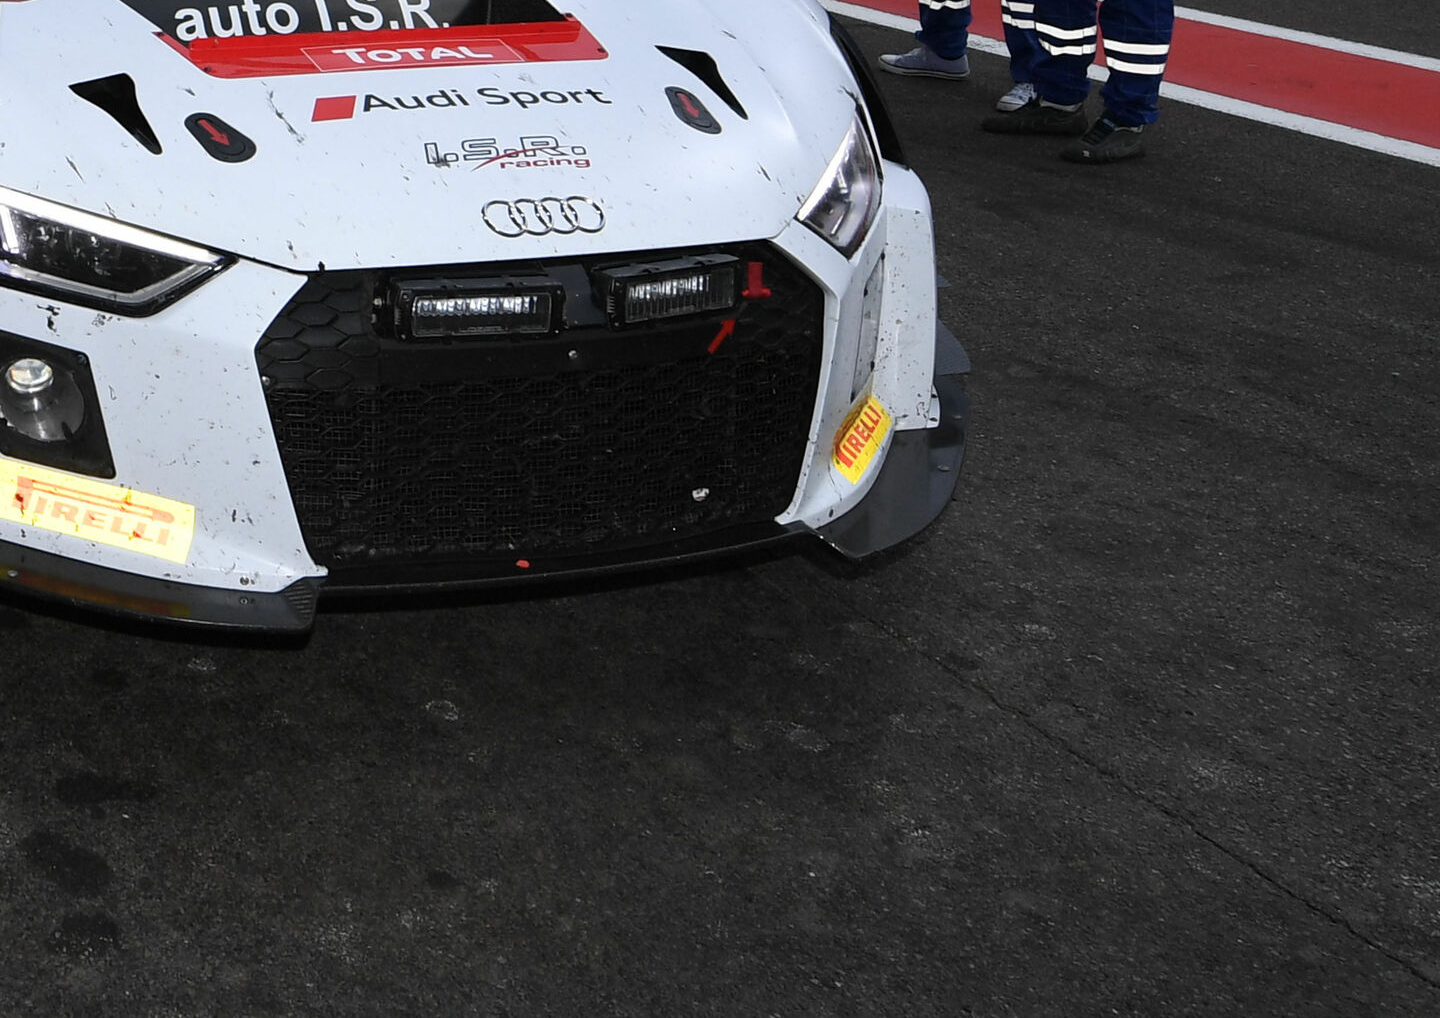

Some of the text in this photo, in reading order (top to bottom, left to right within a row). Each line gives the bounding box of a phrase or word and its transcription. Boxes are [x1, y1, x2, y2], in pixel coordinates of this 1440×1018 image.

[331, 45, 494, 64] TOTAL
[362, 87, 614, 113] Audi Sport
[498, 154, 592, 170] racing
[834, 398, 883, 469] PIRELLI
[12, 475, 175, 547] PIRELLI
